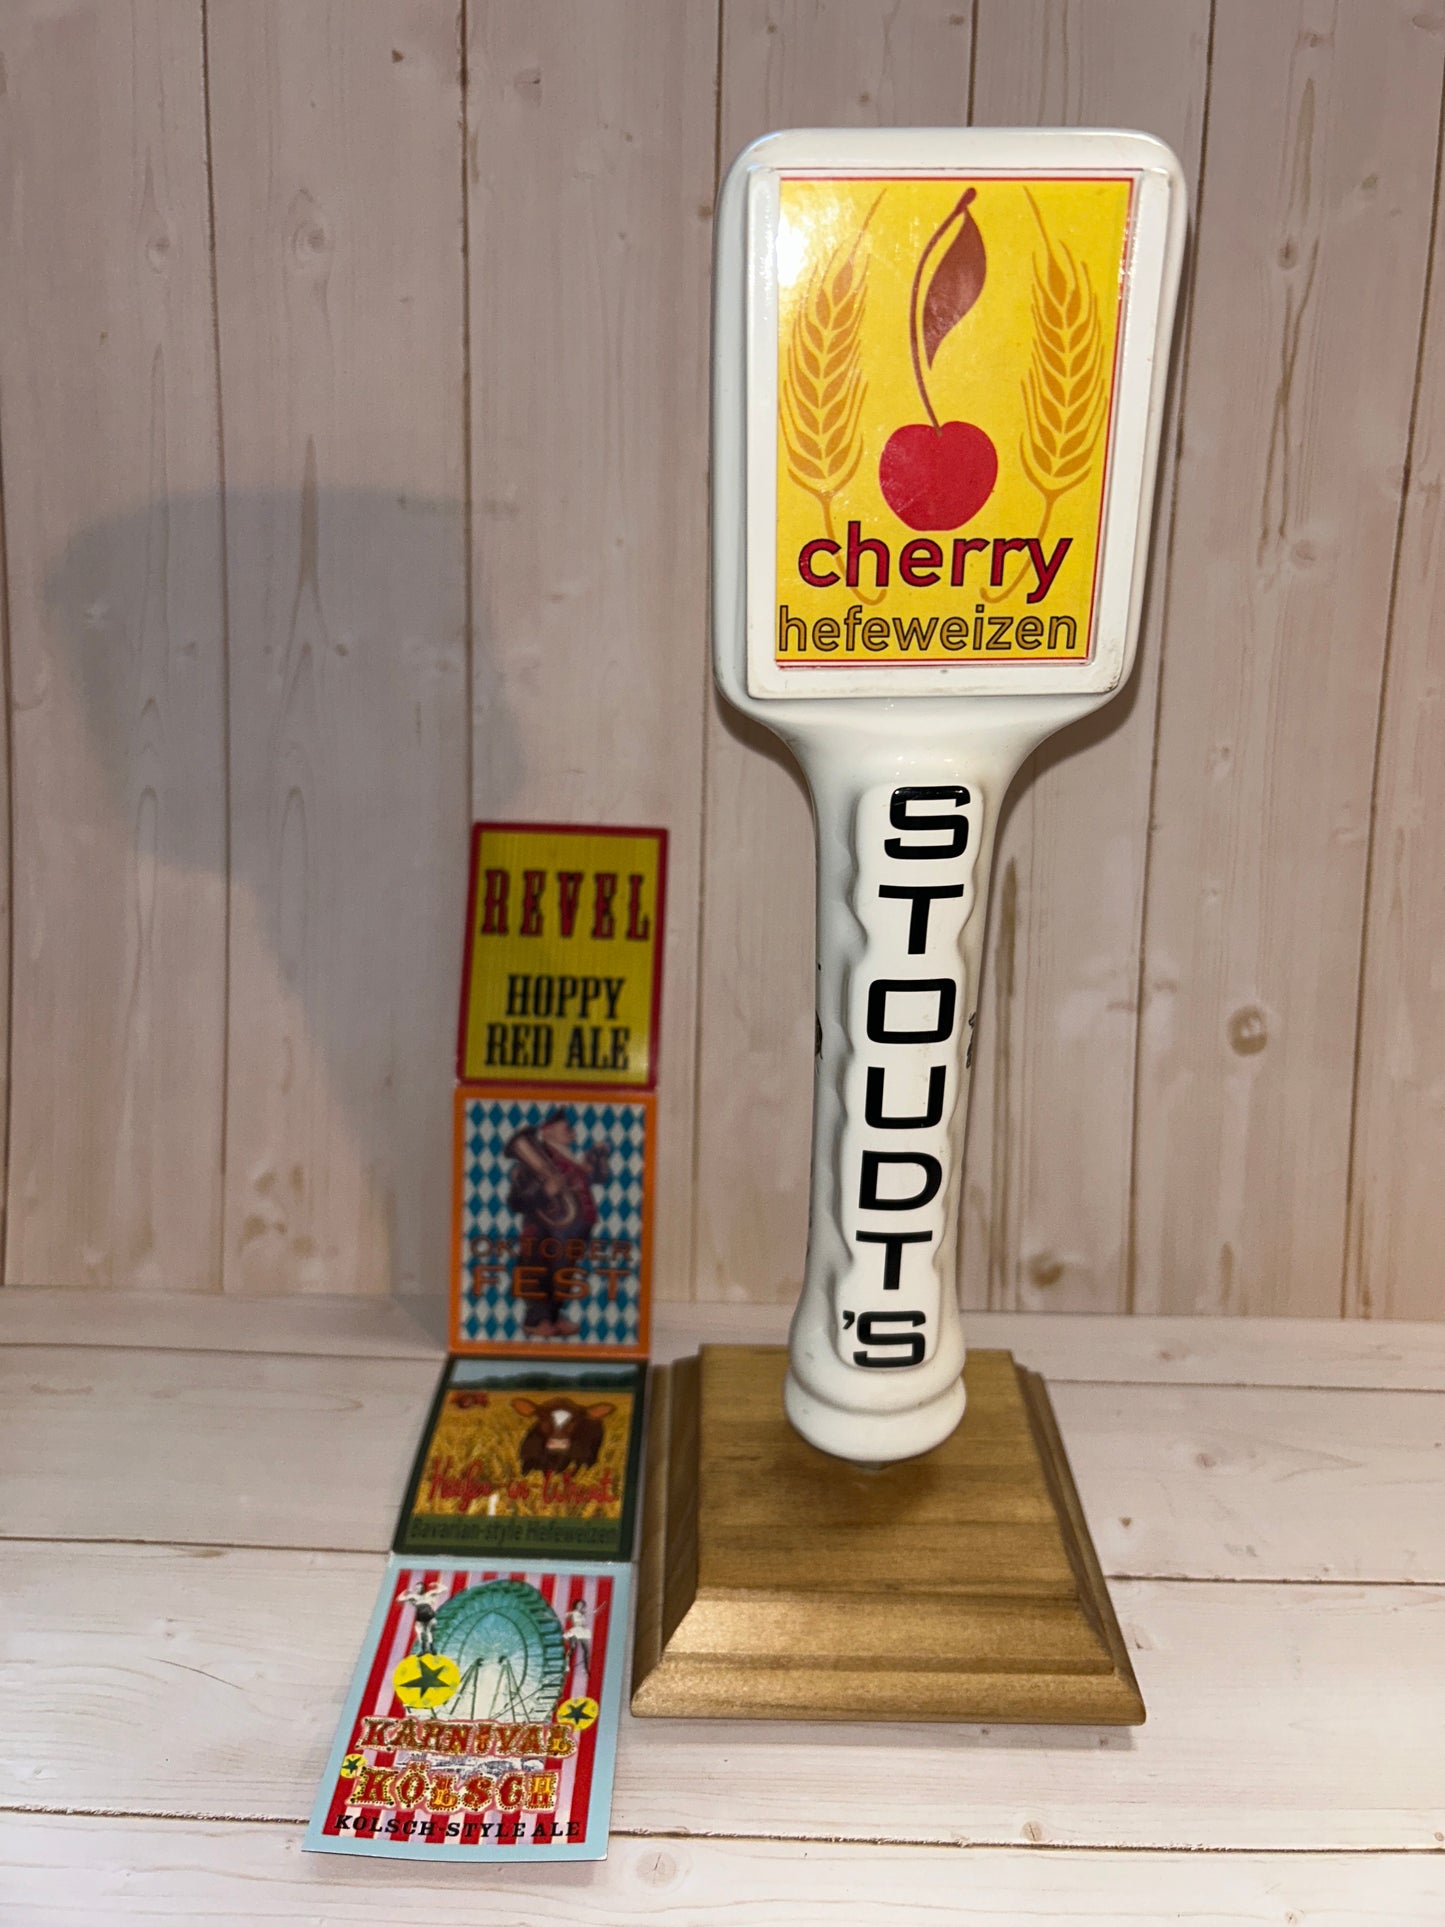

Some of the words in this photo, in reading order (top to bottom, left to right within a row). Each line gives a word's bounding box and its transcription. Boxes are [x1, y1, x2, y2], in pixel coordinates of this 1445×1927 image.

[799, 521, 1073, 604] cherry
[778, 604, 1077, 652] hefeweizen
[481, 869, 650, 941] REVEL
[505, 974, 625, 1020] HOPPY
[484, 1023, 554, 1068] RED
[565, 1025, 630, 1070] ALE
[470, 1233, 635, 1262] OKTOBER
[472, 1265, 632, 1301] FEST
[355, 1717, 577, 1757] KARNIVAL
[347, 1762, 558, 1812] KÖLSCH
[530, 1821, 581, 1837] ALE
